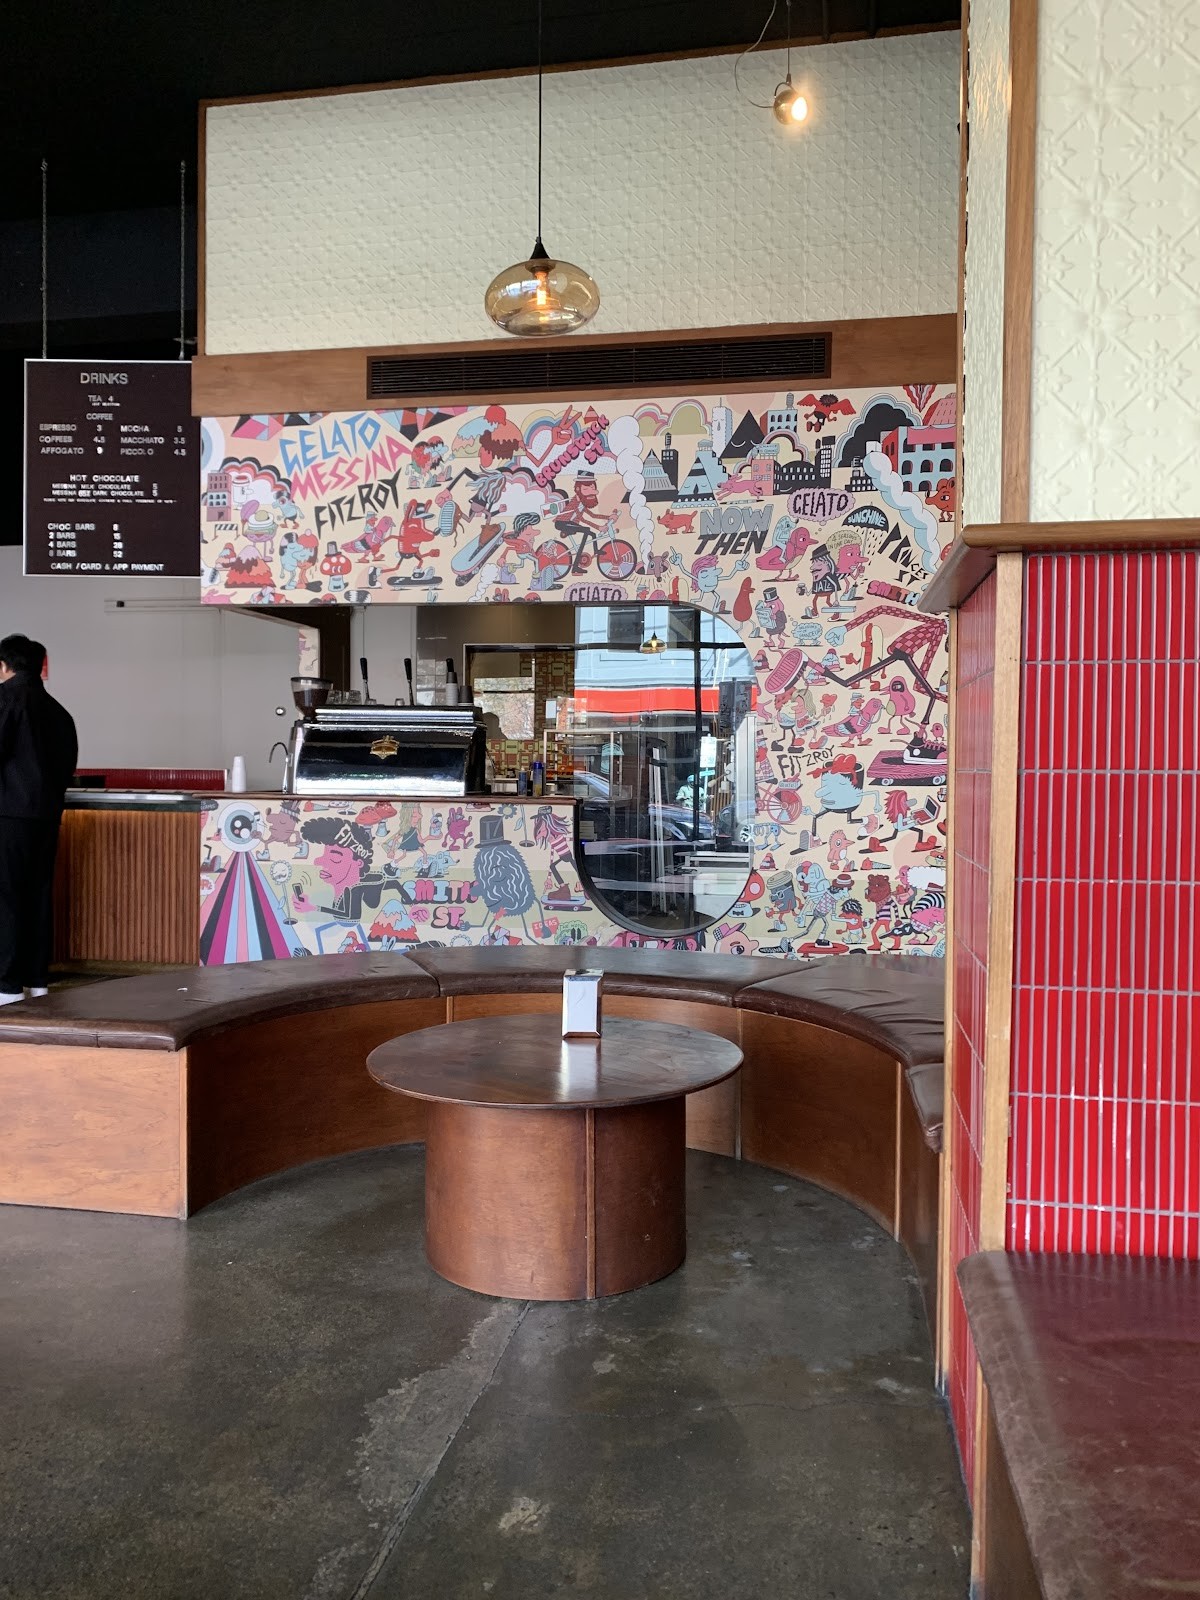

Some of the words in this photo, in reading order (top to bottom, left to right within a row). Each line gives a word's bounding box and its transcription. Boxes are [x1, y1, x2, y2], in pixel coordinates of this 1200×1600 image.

[80, 373, 129, 385] DRINKS
[39, 424, 77, 432] ESPRESSO
[120, 436, 165, 444] MACCHIATO
[41, 447, 84, 455] AFFOGATO
[174, 448, 186, 456] 4.5
[279, 412, 381, 478] GELATO
[535, 414, 609, 488] BRUNSWICK
[584, 437, 605, 465] ST
[290, 435, 412, 501] MESSINA
[314, 467, 402, 540] FITZROY
[793, 491, 848, 517] GELATO
[47, 523, 71, 531] CHOC
[75, 523, 95, 531] BARS
[700, 504, 774, 535] NOW
[848, 509, 886, 527] SUNSHINE
[56, 541, 77, 549] BARS
[694, 530, 769, 556] THEN
[50, 563, 72, 571] CASH
[113, 563, 129, 571] APP
[866, 580, 920, 606] SMITH
[776, 744, 835, 779] FITZROY
[334, 823, 373, 859] FITZROY
